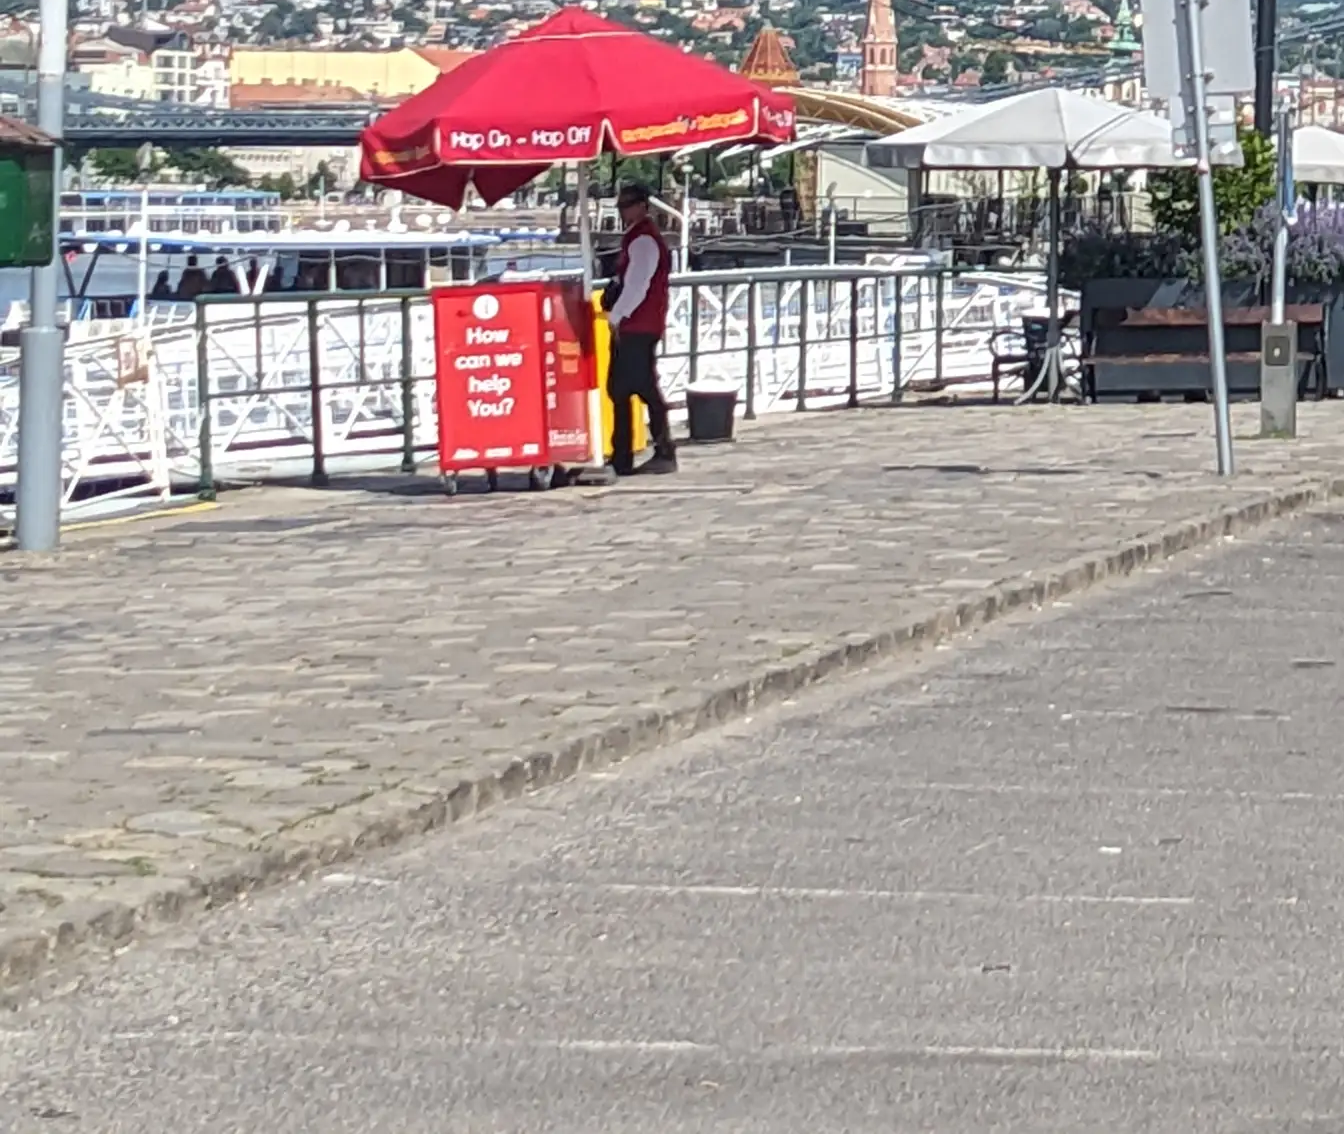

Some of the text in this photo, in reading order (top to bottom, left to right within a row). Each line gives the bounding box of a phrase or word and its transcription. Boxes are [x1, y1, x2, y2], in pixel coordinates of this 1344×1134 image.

[450, 131, 485, 150] Hop
[488, 129, 511, 149] On
[531, 129, 564, 147] Hop
[567, 126, 592, 145] Off
[466, 327, 509, 345] How
[455, 352, 523, 370] can we
[468, 374, 511, 396] help
[467, 397, 515, 417] You?
